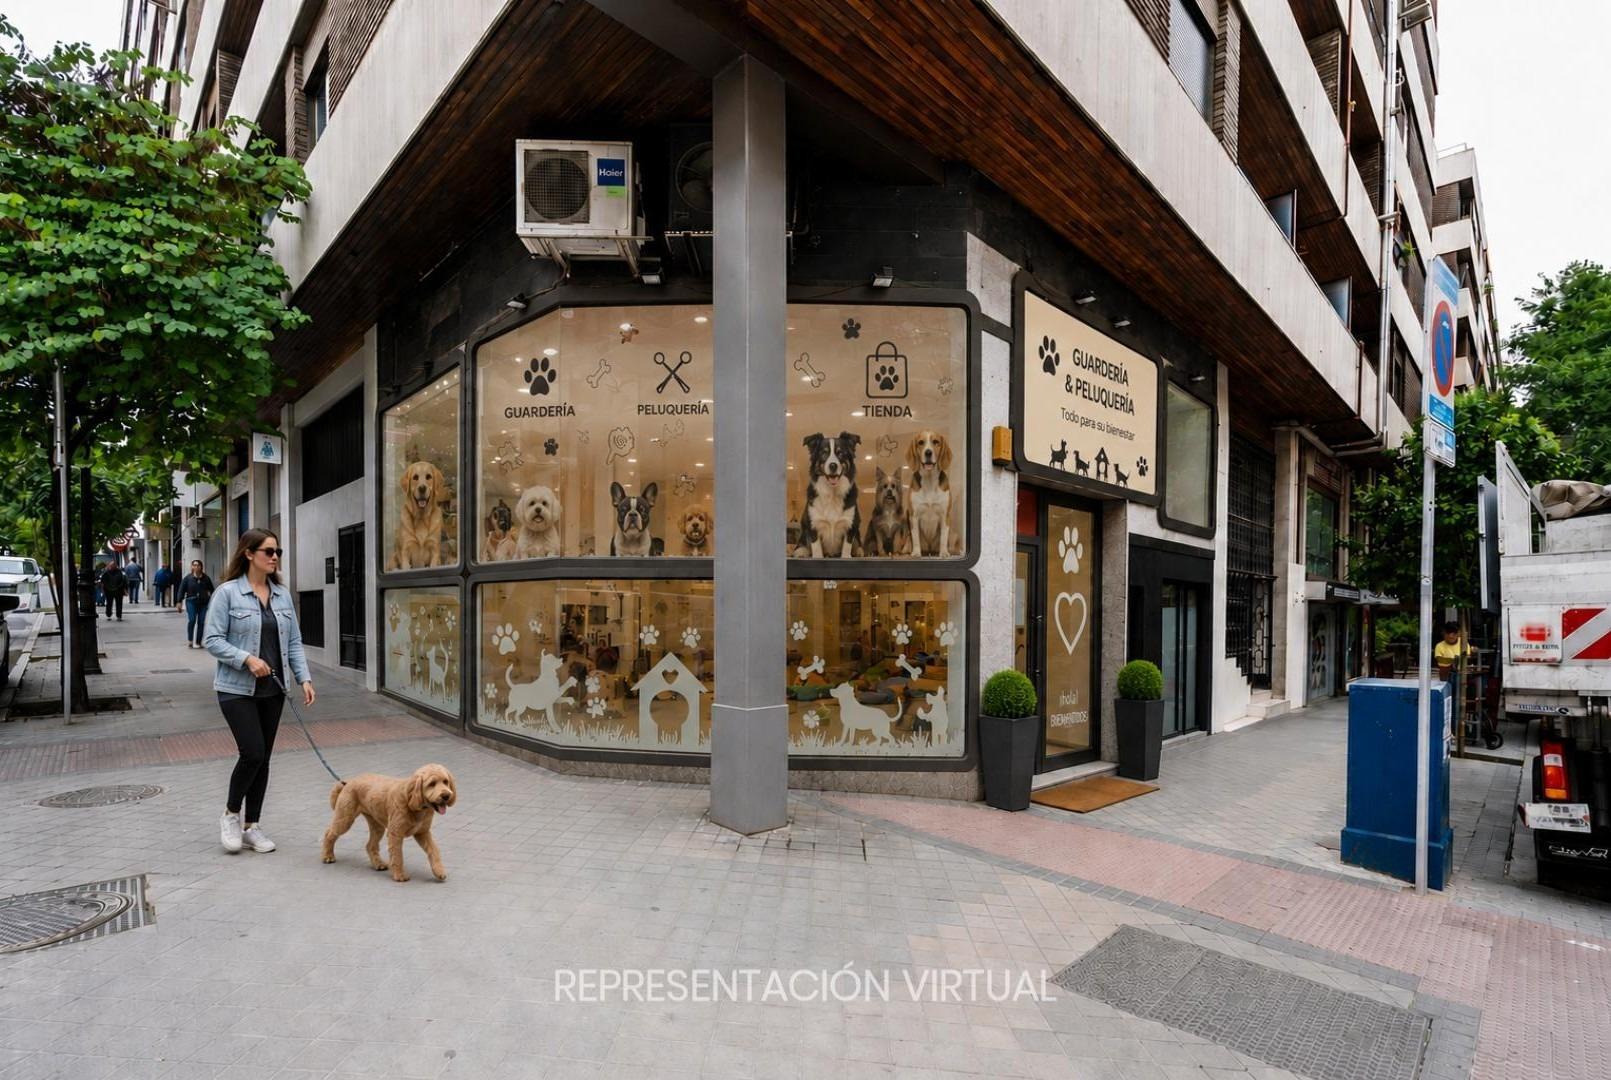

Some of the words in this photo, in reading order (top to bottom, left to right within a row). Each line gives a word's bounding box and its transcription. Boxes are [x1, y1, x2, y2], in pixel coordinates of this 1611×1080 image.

[599, 168, 623, 177] Haier
[1072, 348, 1129, 387] GUARDERÍA
[1065, 373, 1073, 394] &
[1075, 378, 1135, 416] PELUQUERÍA
[504, 402, 576, 419] GUARDERÍA
[637, 401, 709, 416] PELUQUERÍA
[861, 405, 913, 418] TIENDA
[1060, 407, 1080, 424] Todo
[1080, 416, 1096, 429] para
[1097, 421, 1105, 432] su
[1106, 421, 1135, 441] bienestar
